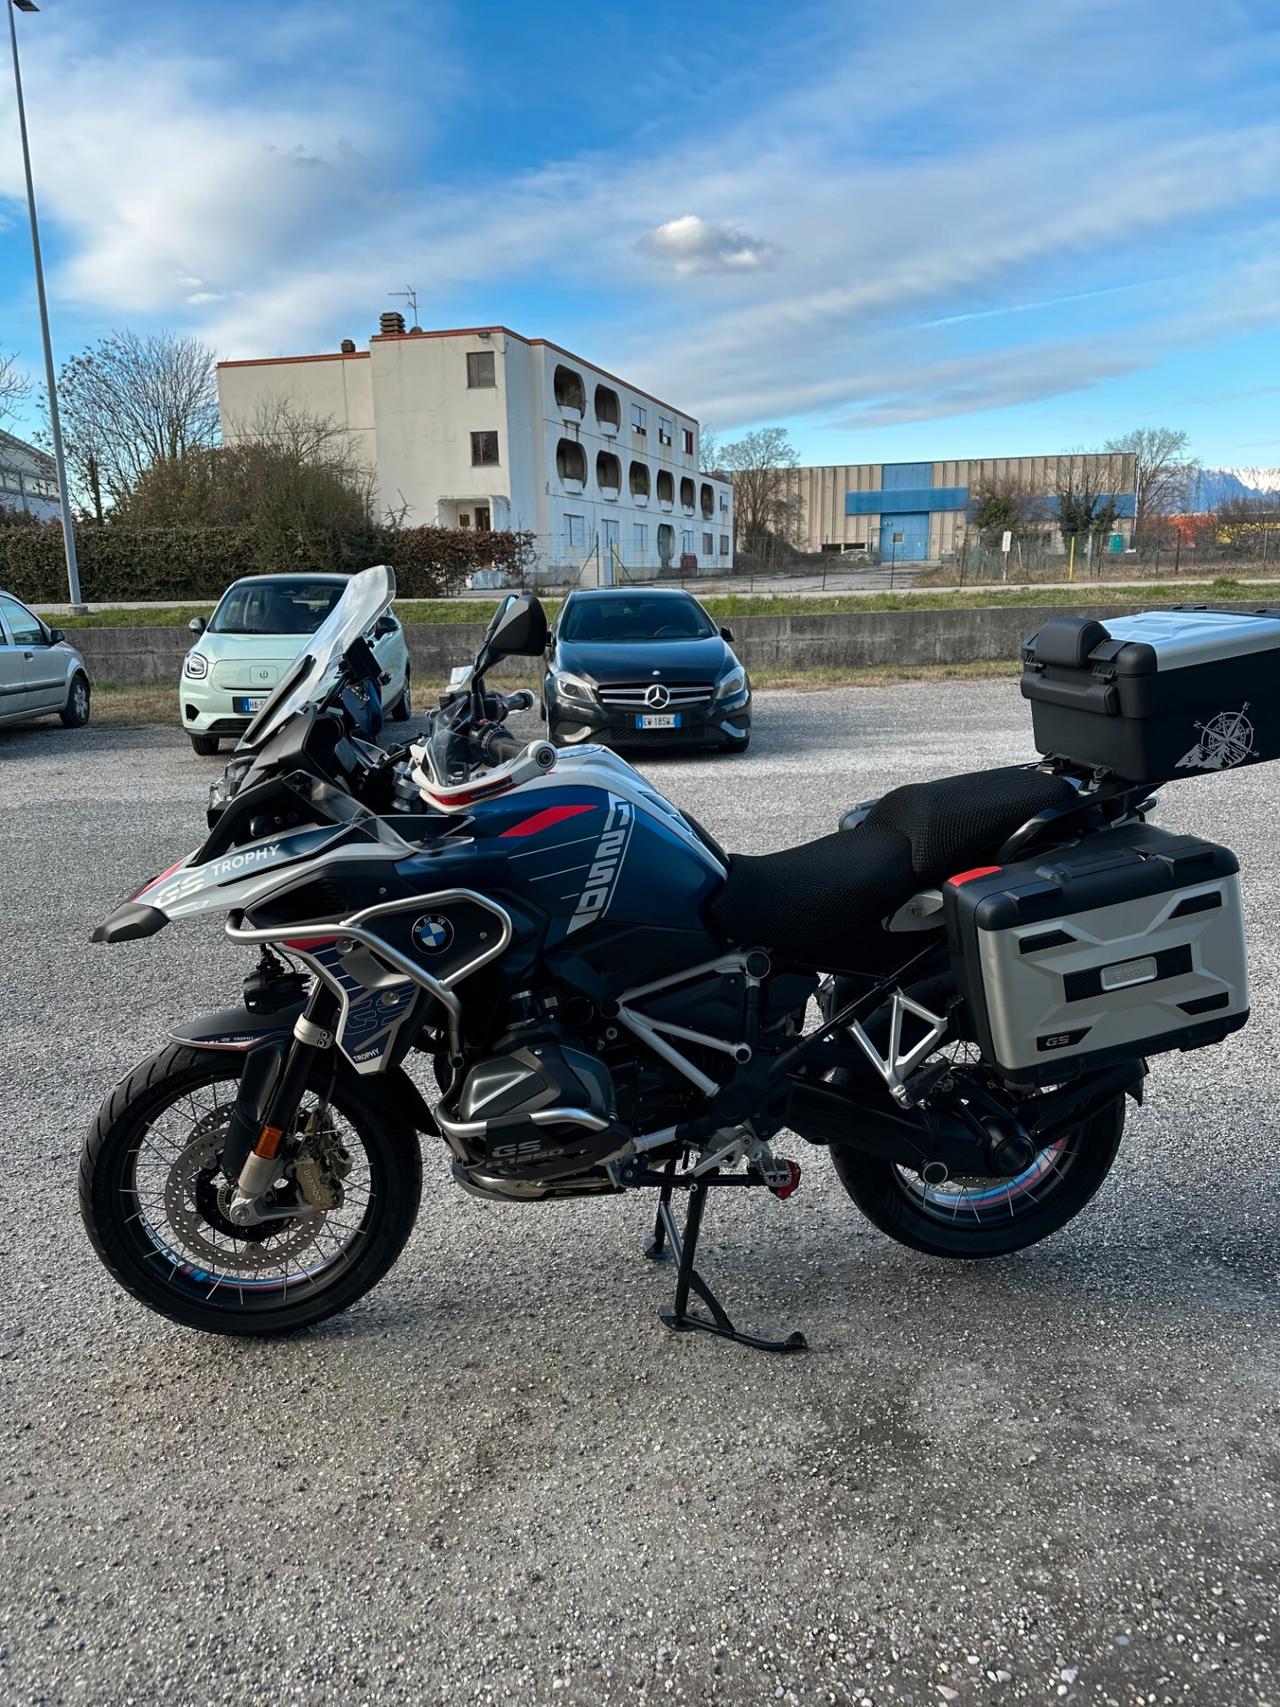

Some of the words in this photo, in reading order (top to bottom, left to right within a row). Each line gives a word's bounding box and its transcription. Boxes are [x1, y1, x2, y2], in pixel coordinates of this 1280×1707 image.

[152, 869, 208, 907] GS
[211, 844, 280, 876] TROPHY
[414, 916, 447, 933] BMW
[1046, 1035, 1071, 1047] GS
[352, 1047, 380, 1062] TROPHY
[491, 1140, 541, 1158] GS
[304, 1169, 322, 1201] brembo
